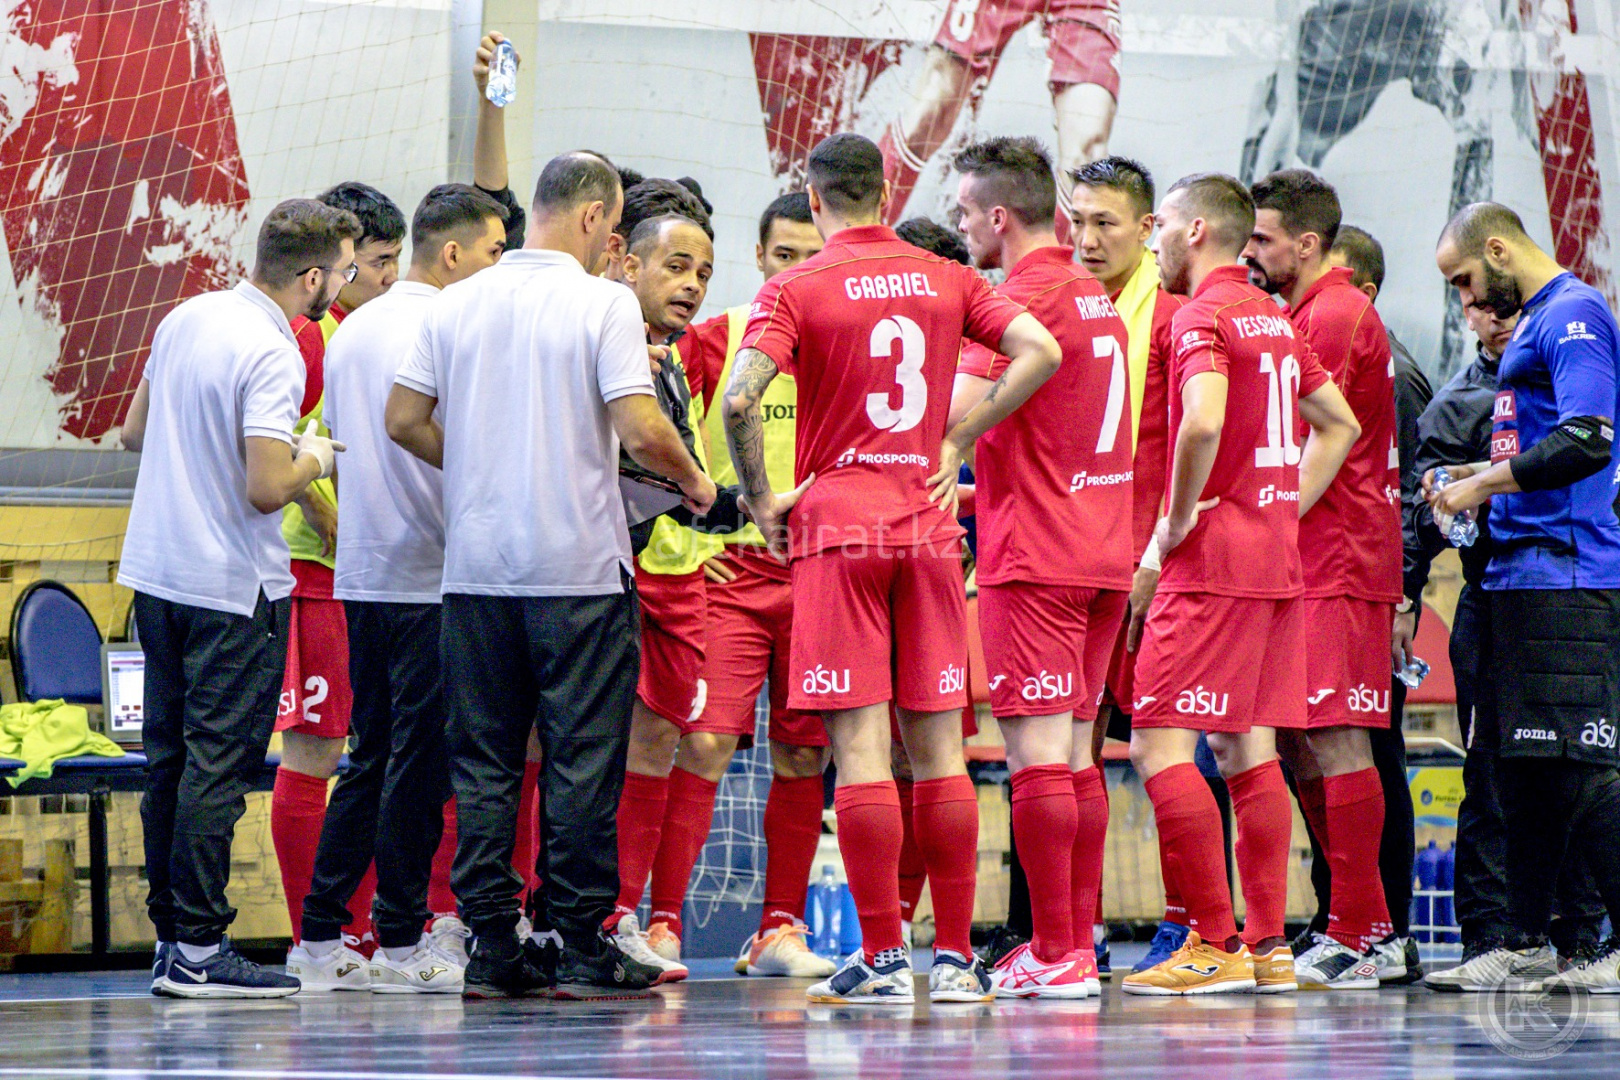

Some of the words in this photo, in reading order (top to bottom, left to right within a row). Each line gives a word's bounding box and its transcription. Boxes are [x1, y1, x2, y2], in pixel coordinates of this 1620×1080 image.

[845, 272, 938, 300] GABRIEL
[866, 315, 928, 433] 3
[1092, 335, 1126, 454] 7
[1255, 352, 1301, 468] 10
[302, 675, 329, 723] 2
